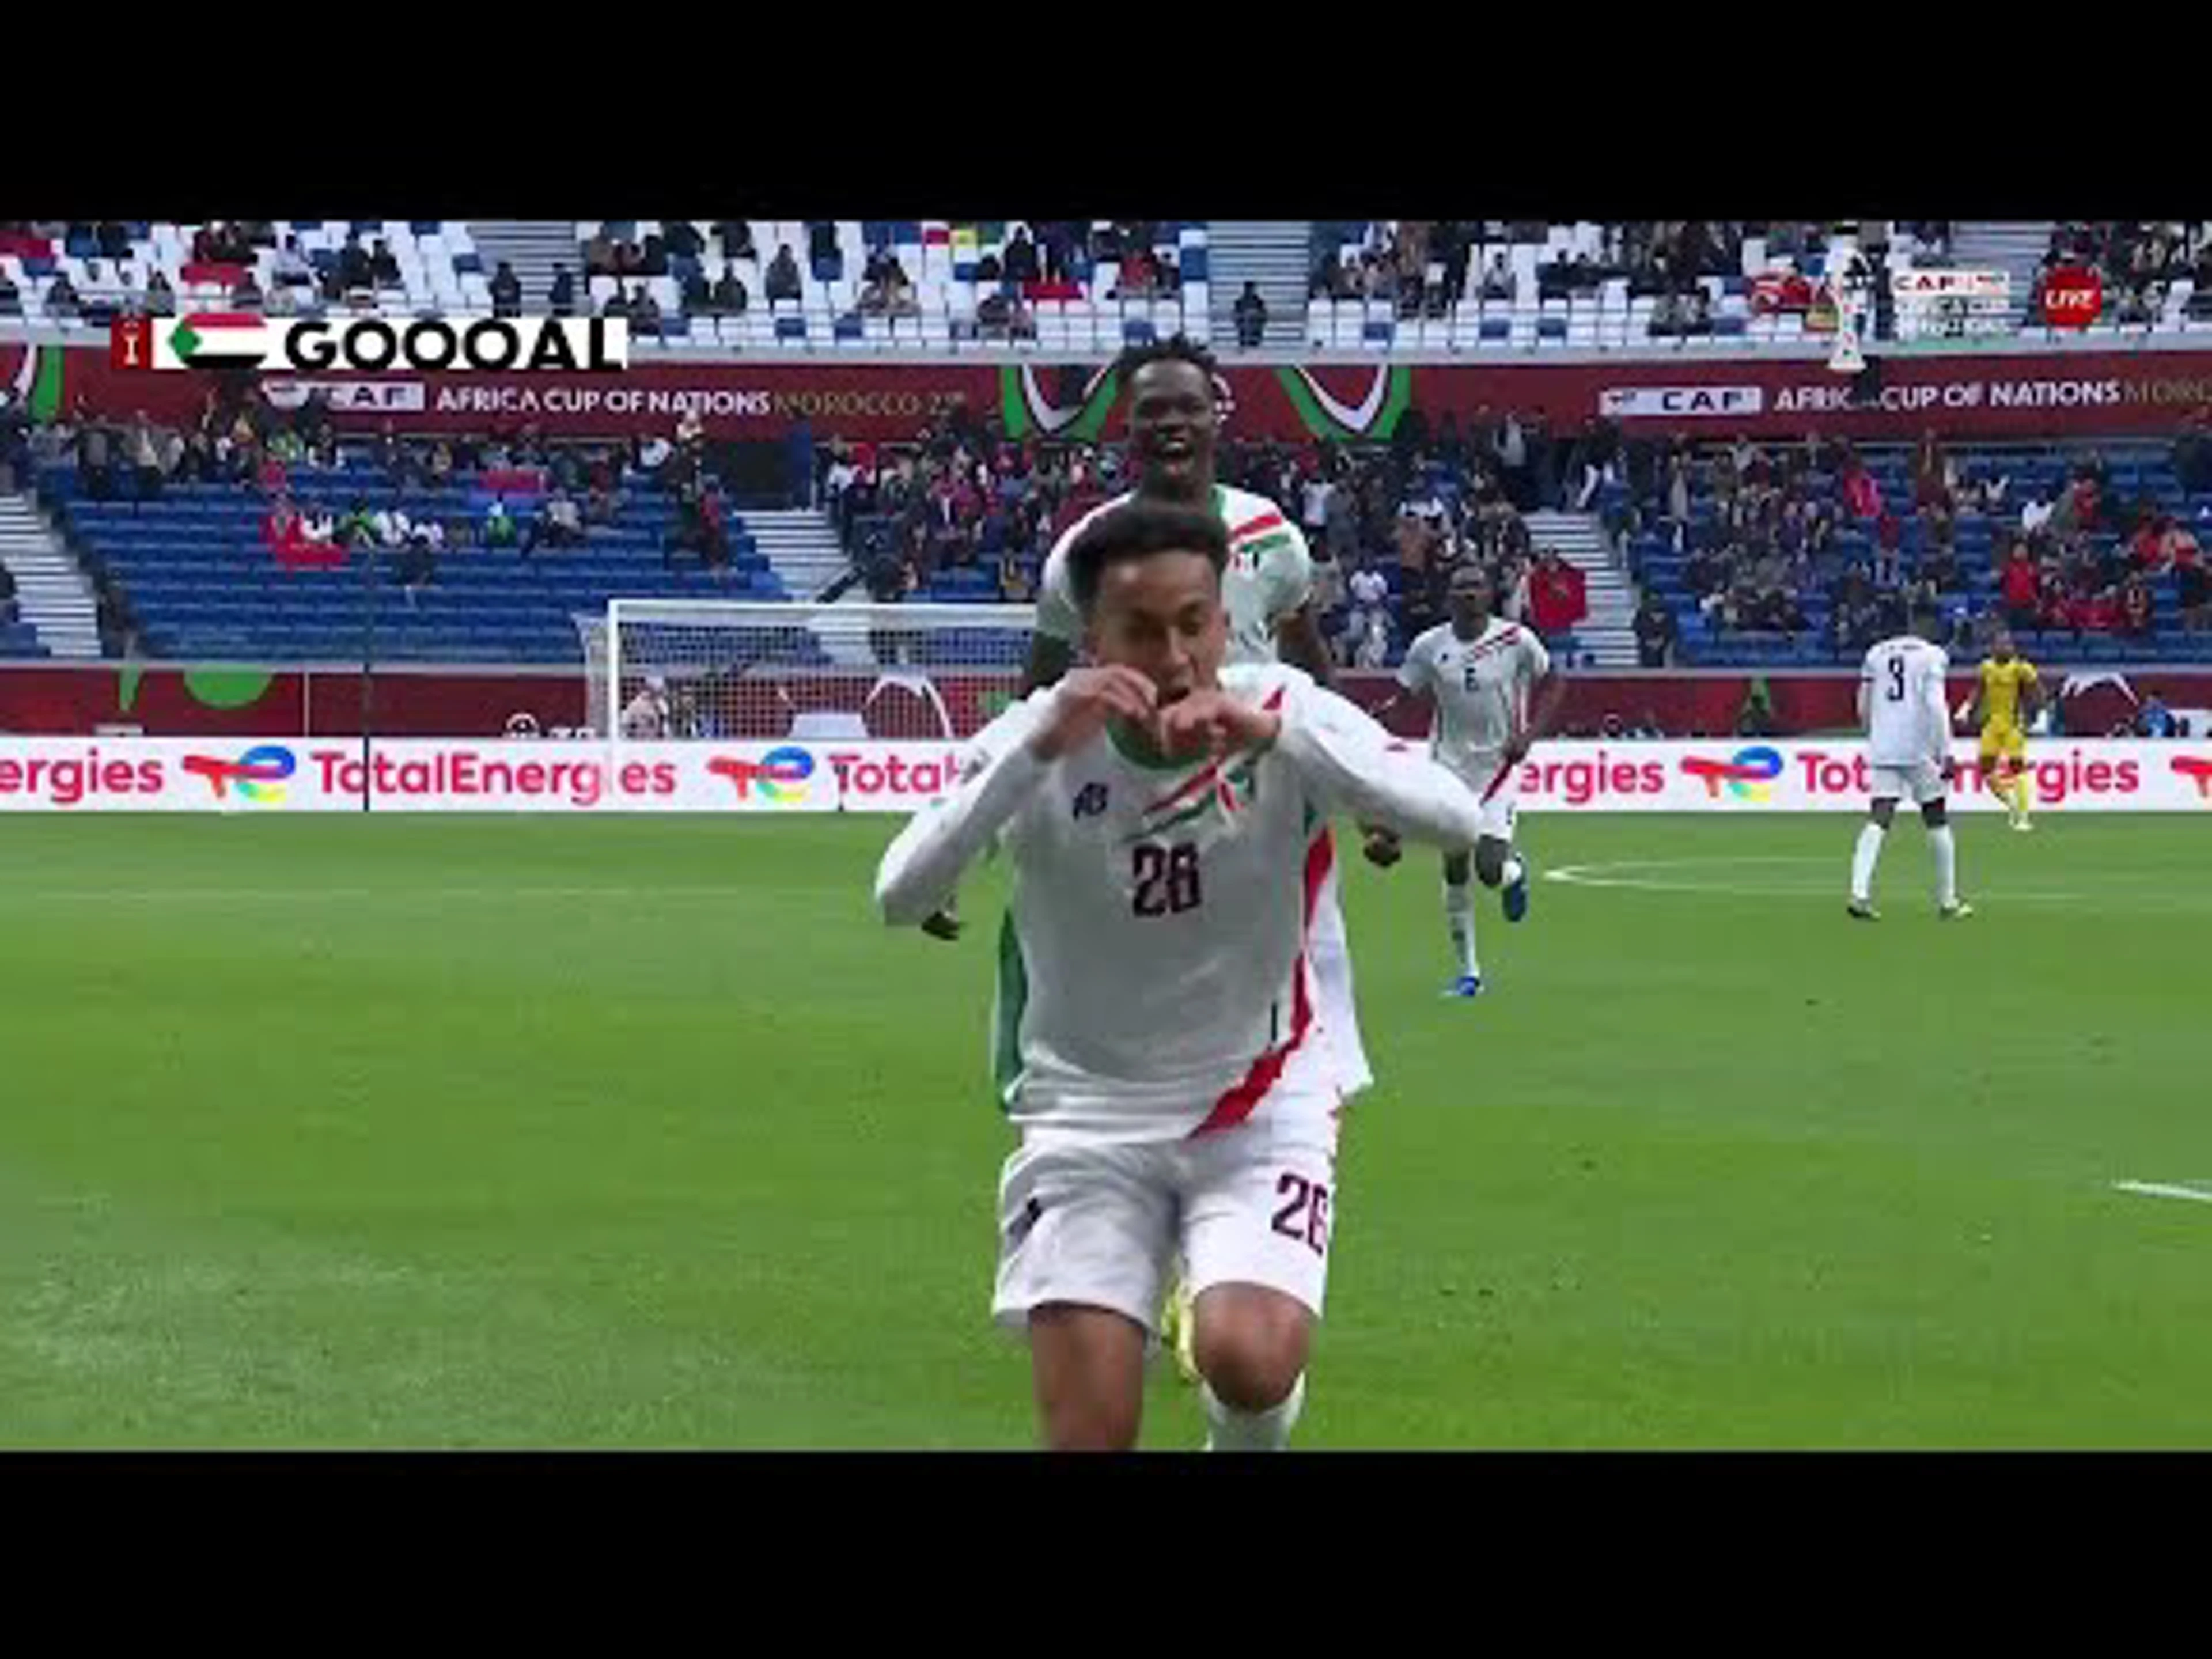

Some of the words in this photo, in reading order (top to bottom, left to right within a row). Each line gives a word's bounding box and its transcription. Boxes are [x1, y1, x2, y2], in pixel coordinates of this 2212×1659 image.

[437, 387, 539, 412] AFRICA
[543, 388, 600, 412] CUP
[604, 389, 645, 412] OF
[648, 389, 771, 414] NATIONS
[1662, 391, 1742, 411] CAF
[1773, 387, 1876, 411] AFRIC
[1880, 385, 1938, 411] CUP
[1943, 383, 1982, 407] OF
[1990, 380, 2121, 406] NATIONS
[310, 752, 676, 805] TotalEnerges
